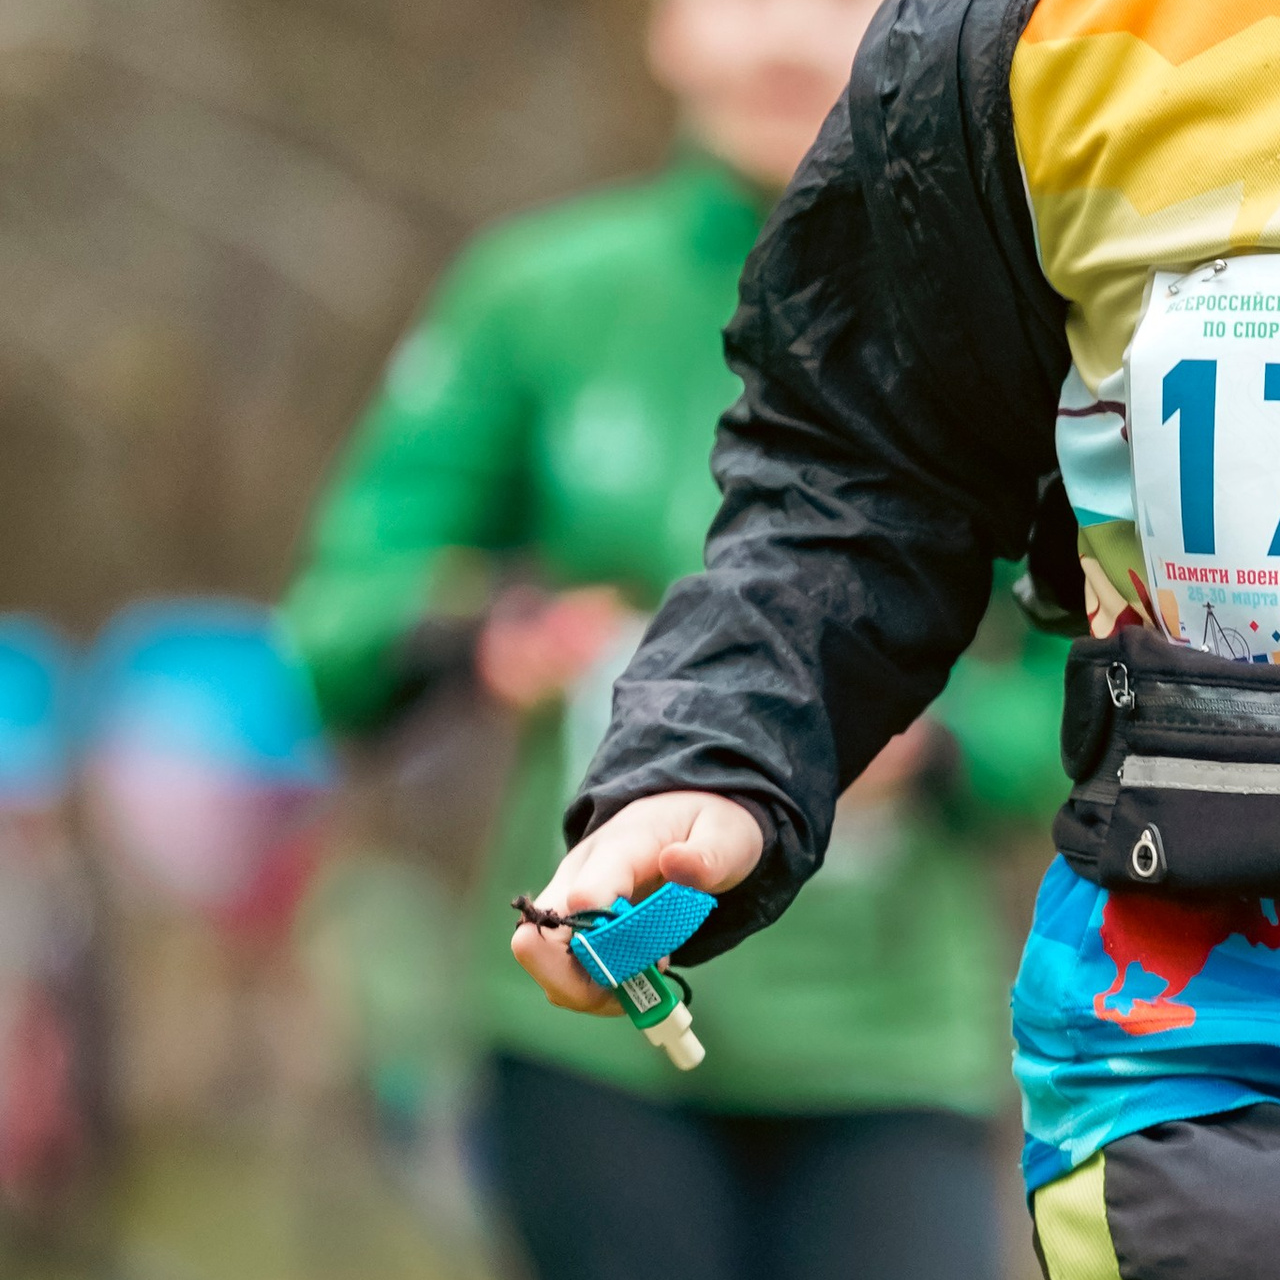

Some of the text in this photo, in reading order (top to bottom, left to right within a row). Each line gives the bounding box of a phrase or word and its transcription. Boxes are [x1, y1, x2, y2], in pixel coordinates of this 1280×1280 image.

[1203, 321, 1226, 338] ПО
[1165, 562, 1230, 584] Памяти
[1232, 590, 1279, 609] марта
